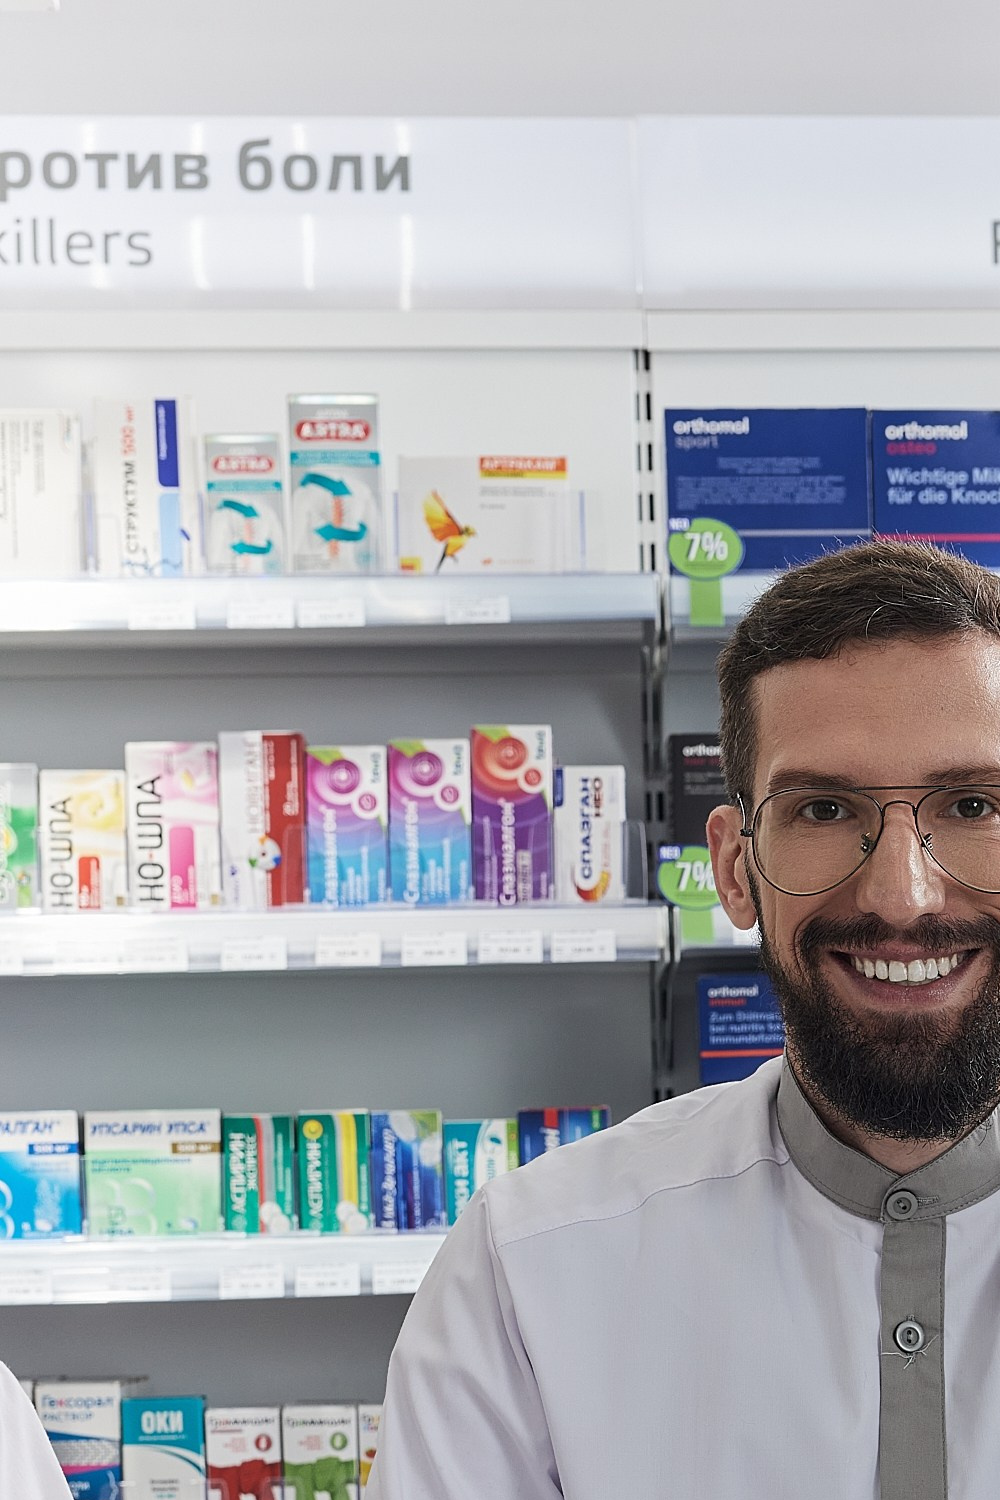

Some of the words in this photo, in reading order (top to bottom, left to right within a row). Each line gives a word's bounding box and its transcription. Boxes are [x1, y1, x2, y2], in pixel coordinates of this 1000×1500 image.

[0, 151, 209, 203] ротив
[236, 139, 413, 194] боли
[672, 415, 750, 436] orthomol
[884, 420, 968, 440] orthomol
[886, 440, 937, 456] osteo
[886, 466, 969, 489] Wichtige
[887, 486, 915, 504] für
[918, 486, 948, 505] die
[684, 531, 729, 562] 7%
[136, 775, 165, 903] НО-ШПА
[580, 778, 592, 880] СПАЗГАН
[707, 984, 759, 999] orthomol
[228, 1132, 247, 1215] АСПИРИН
[141, 1410, 184, 1434] ОКИ
